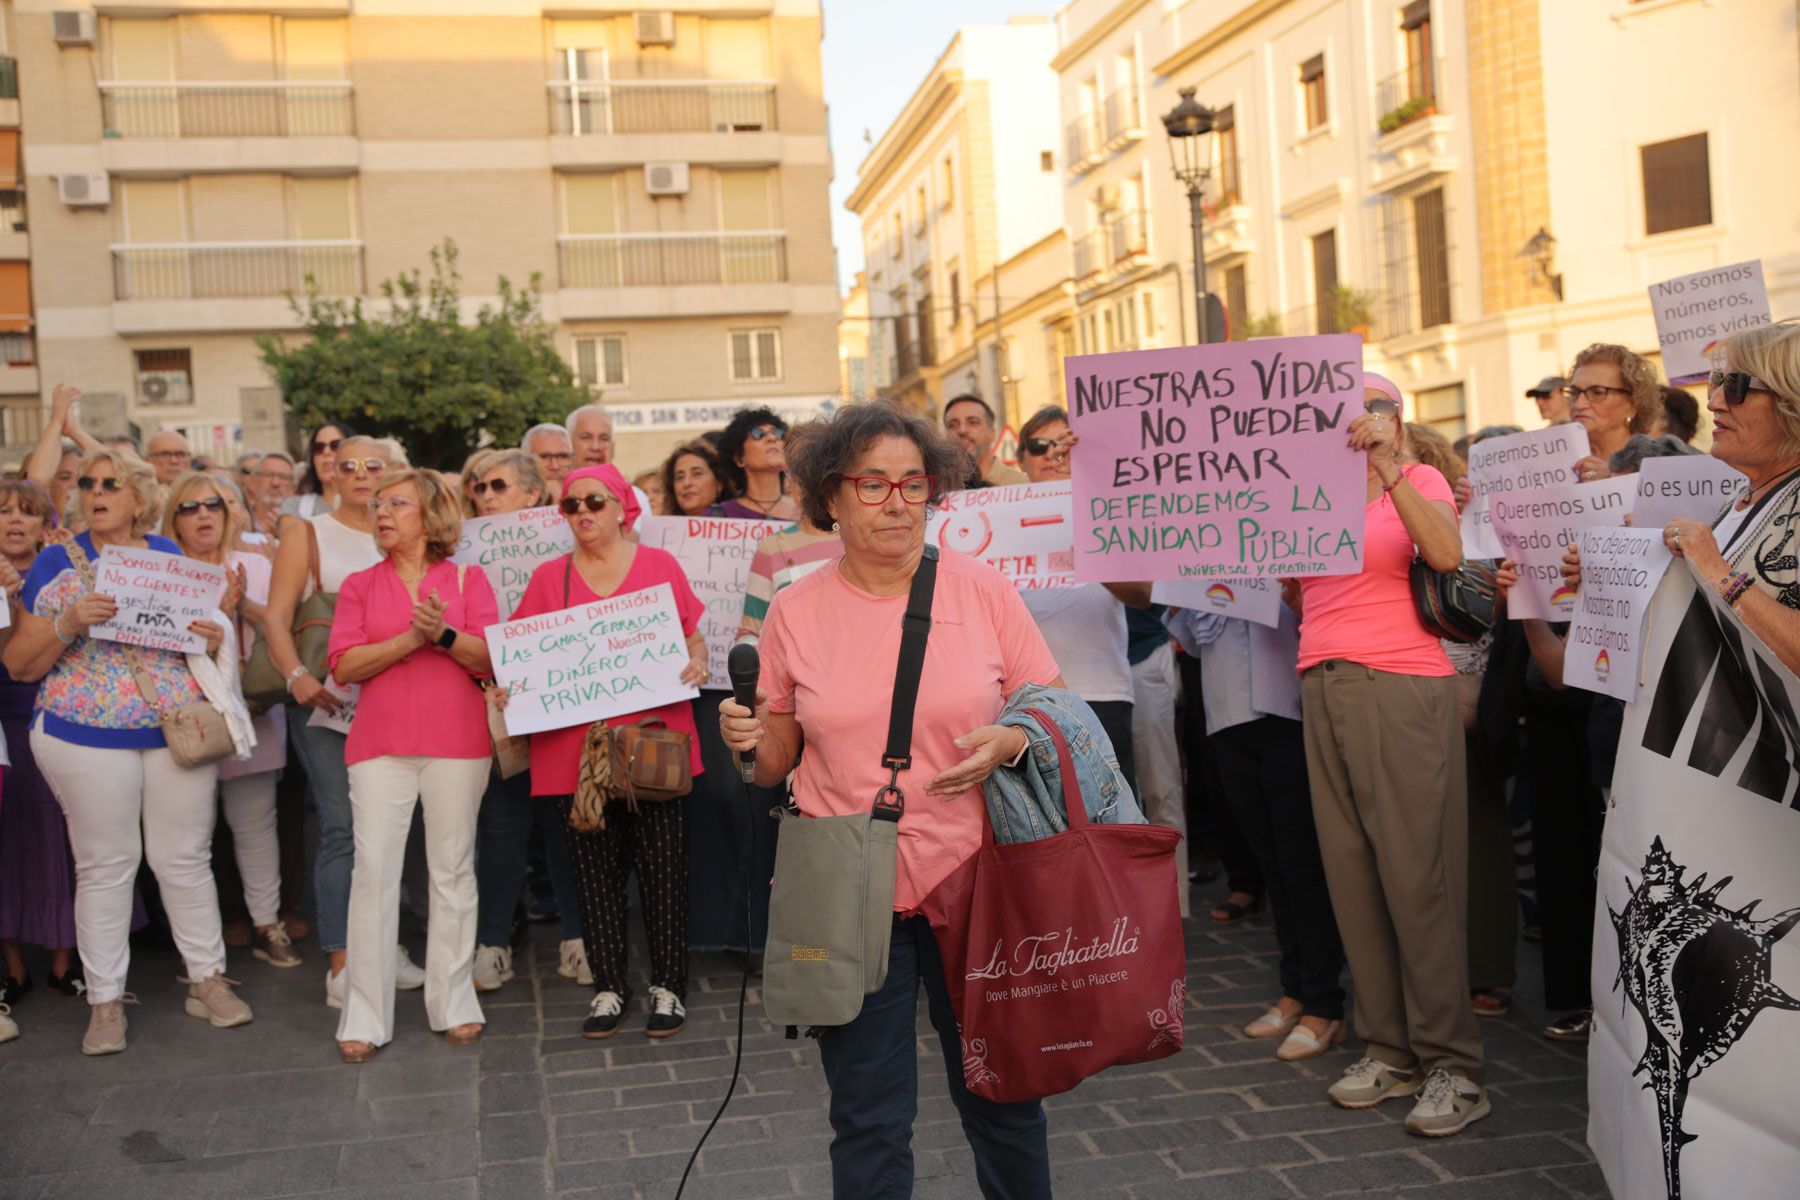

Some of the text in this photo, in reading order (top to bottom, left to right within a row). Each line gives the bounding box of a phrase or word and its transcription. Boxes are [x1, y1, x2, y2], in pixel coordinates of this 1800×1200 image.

[1659, 266, 1753, 297] No somos
[1664, 292, 1754, 320] números,
[1075, 368, 1235, 418] NUESTRAS
[1141, 402, 1346, 450] NO PUEDEN
[1544, 438, 1568, 455] un
[1113, 448, 1291, 488] ESPERAR
[1292, 484, 1332, 512] LA
[1471, 468, 1566, 499] ribado digno
[1661, 480, 1682, 497] es
[1688, 479, 1713, 496] un
[1496, 491, 1623, 523] Queremos un
[479, 522, 538, 545] CAMAS
[1085, 517, 1359, 563] SANIDAD PÚBLICA
[1602, 532, 1650, 560] dejaron
[479, 541, 572, 565] CERRADAS
[104, 569, 127, 586] NO
[1178, 564, 1251, 577] UNIVERSAL
[136, 613, 176, 629] MATA
[503, 592, 659, 640] BONILLA DIMISIÓN
[1617, 599, 1630, 619] no
[501, 610, 671, 666] LAS CAMAS CERRADAS
[608, 631, 656, 651] Nuestro
[1575, 625, 1592, 645] nos
[548, 652, 632, 688] DINERO
[640, 648, 665, 664] A
[660, 642, 686, 659] LA
[540, 675, 655, 714] PRIVADA
[965, 938, 1007, 981] La
[986, 970, 1129, 1003] Dove Mangiare è un Piacere
